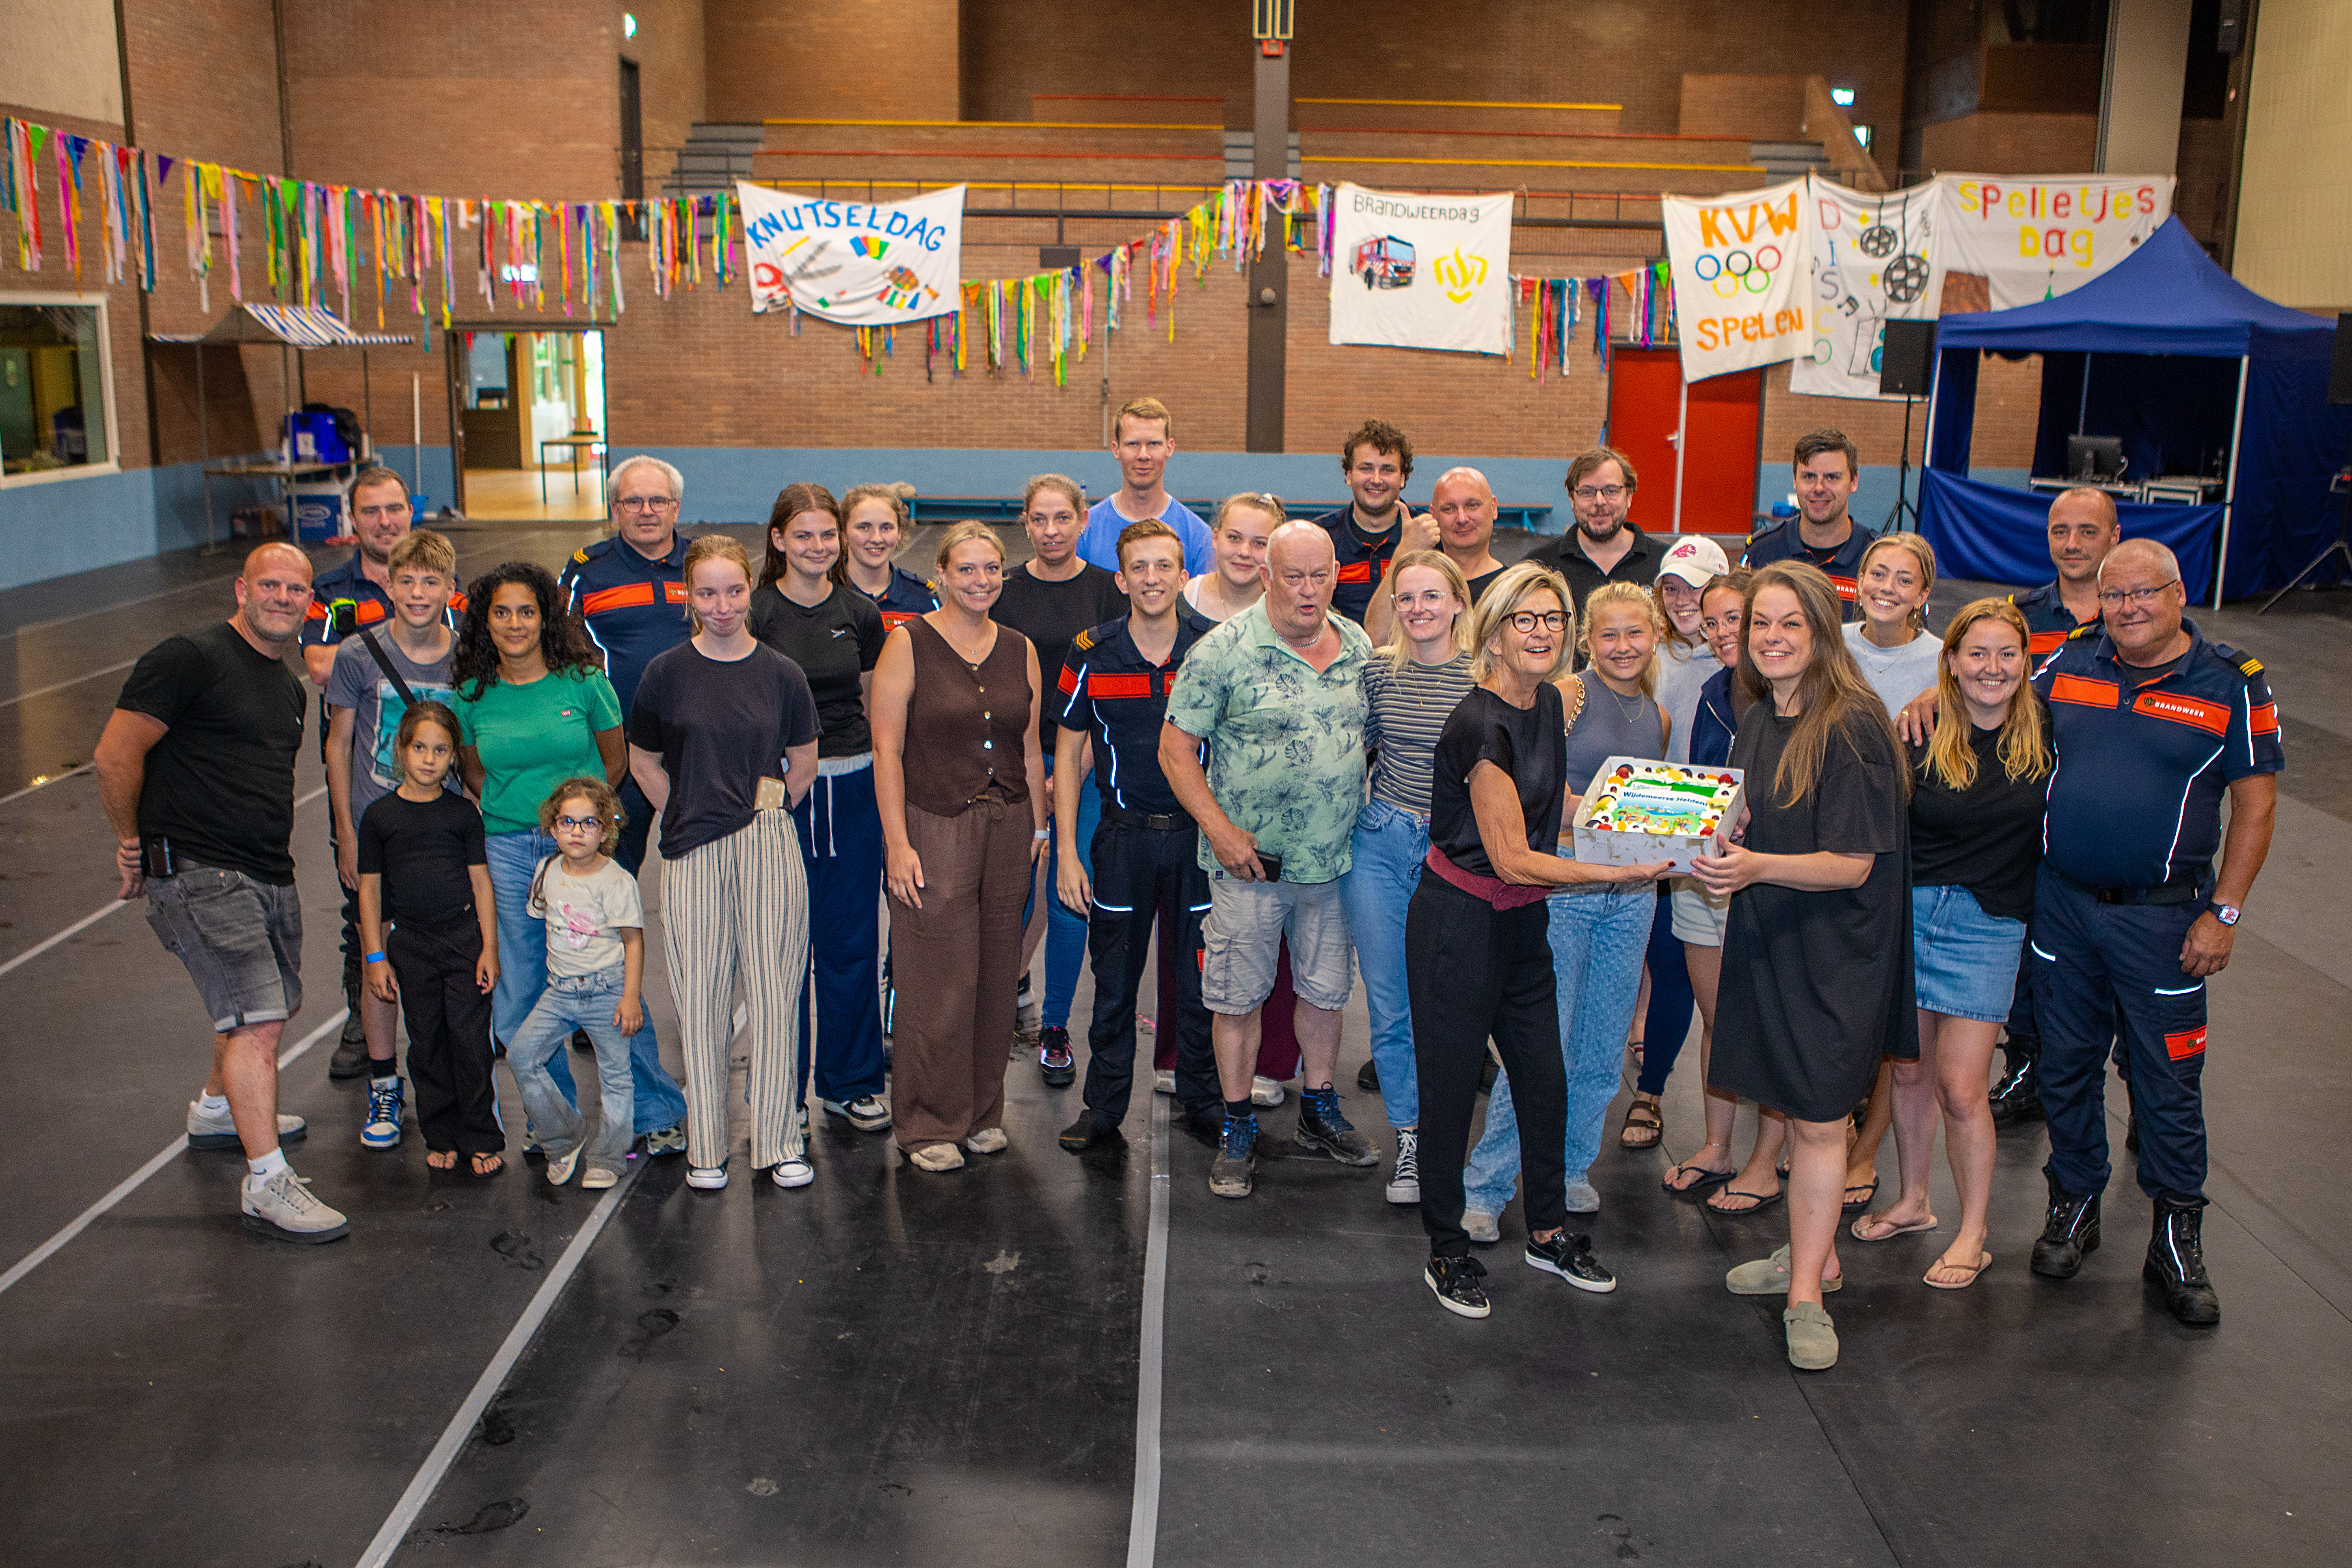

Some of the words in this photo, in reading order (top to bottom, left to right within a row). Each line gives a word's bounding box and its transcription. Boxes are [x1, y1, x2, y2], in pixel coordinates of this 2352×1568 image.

[746, 201, 945, 251] KNUTSELDAG
[1699, 193, 1797, 248] KVW
[2154, 701, 2204, 718] BRANDWEER
[1623, 792, 1674, 801] Wijdemeerse
